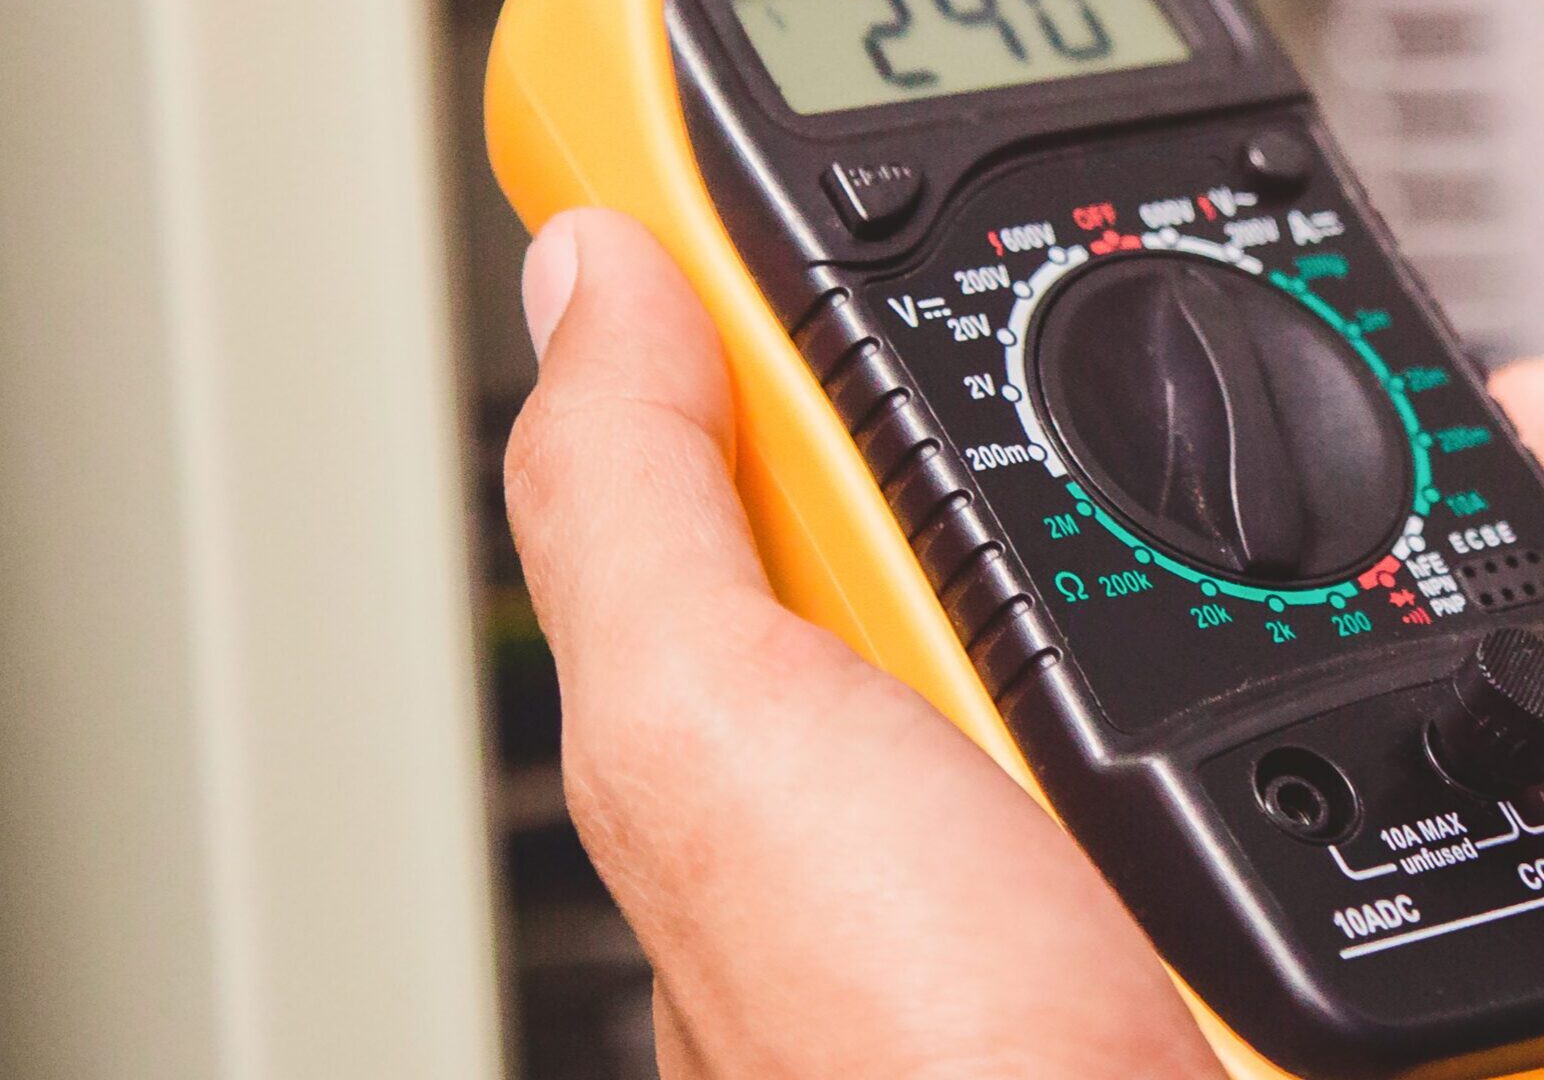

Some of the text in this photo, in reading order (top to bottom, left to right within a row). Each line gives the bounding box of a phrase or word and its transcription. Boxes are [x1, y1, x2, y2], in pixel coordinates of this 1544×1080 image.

[1000, 222, 1056, 252] 600V
[954, 265, 1010, 295] 200V
[888, 295, 919, 328] V
[948, 314, 991, 342] 20V
[964, 373, 995, 399] 2V
[966, 444, 1030, 471] 200m
[1044, 513, 1080, 539] 2M
[1099, 570, 1153, 598] 200k
[1190, 604, 1233, 629] 20k
[1331, 611, 1373, 637] 200
[1265, 620, 1297, 644] 2k
[1380, 812, 1468, 851] 10A MAX
[1400, 837, 1479, 875] unfused
[1333, 894, 1421, 940] 10ADC
